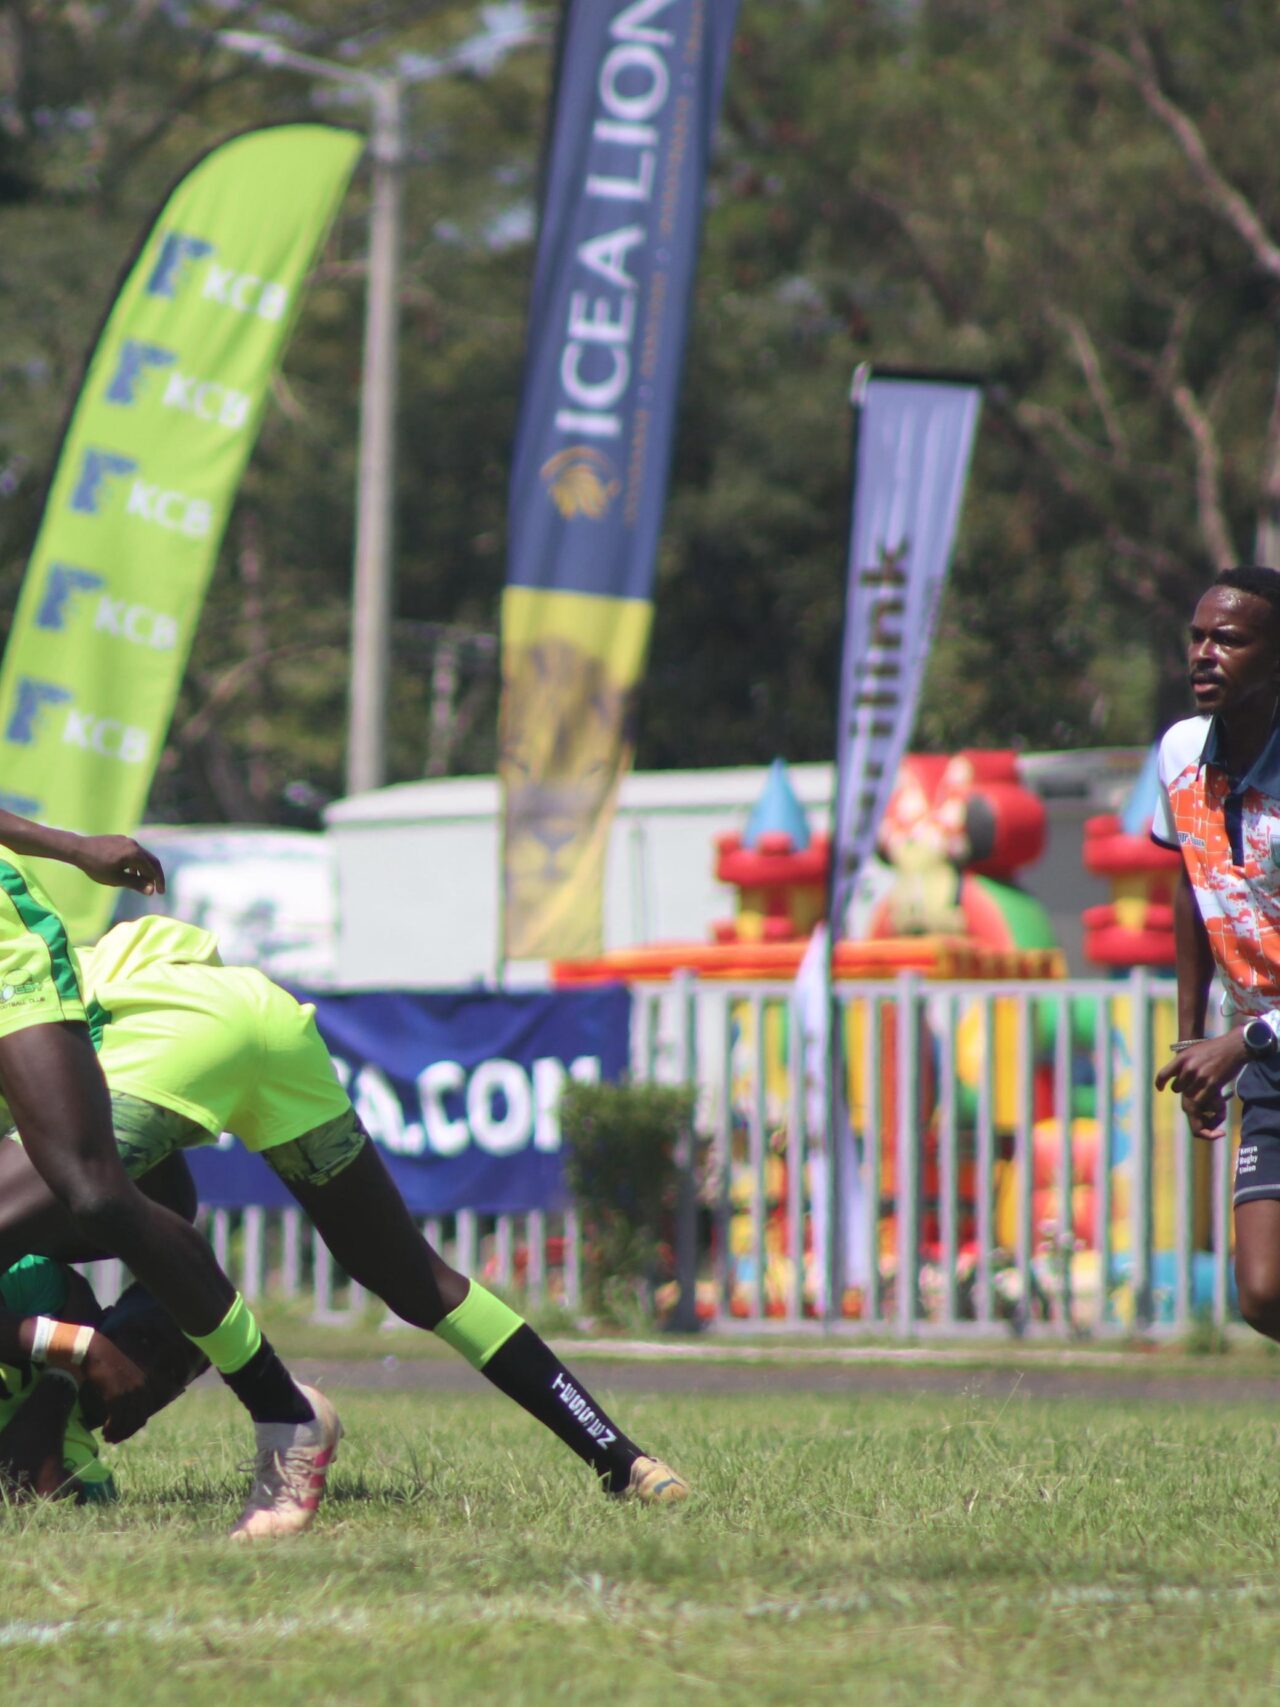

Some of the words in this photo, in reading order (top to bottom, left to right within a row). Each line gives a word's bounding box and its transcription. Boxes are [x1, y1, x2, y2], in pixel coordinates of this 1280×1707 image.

[585, 0, 676, 202] LION
[201, 264, 289, 321] KCB
[554, 226, 646, 437] ICEA
[162, 371, 252, 429] KCB
[127, 479, 212, 537] KCB
[94, 595, 177, 650] KCB
[63, 709, 150, 763] KCB
[552, 1372, 617, 1450] TESSEN
